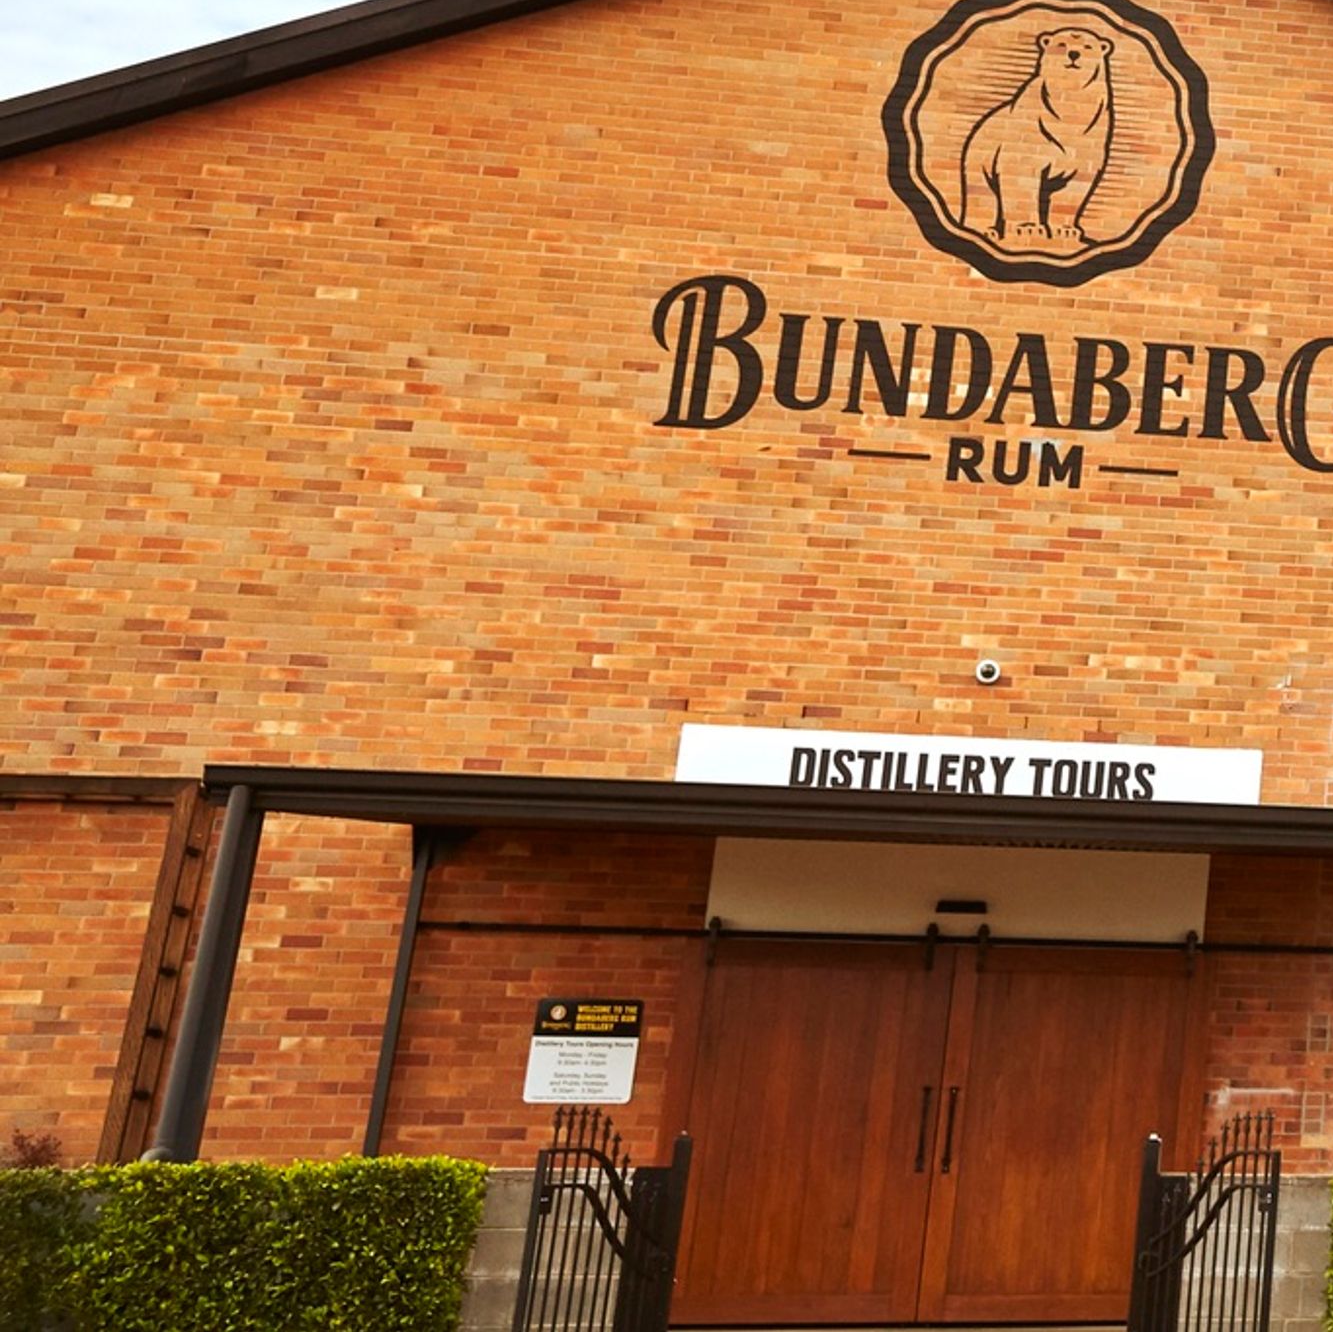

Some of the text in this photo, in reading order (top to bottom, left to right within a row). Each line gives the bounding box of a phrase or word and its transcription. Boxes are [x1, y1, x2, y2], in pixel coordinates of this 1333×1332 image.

[946, 437, 1085, 490] RUM
[788, 746, 1156, 801] DISTILLERY TOURS
